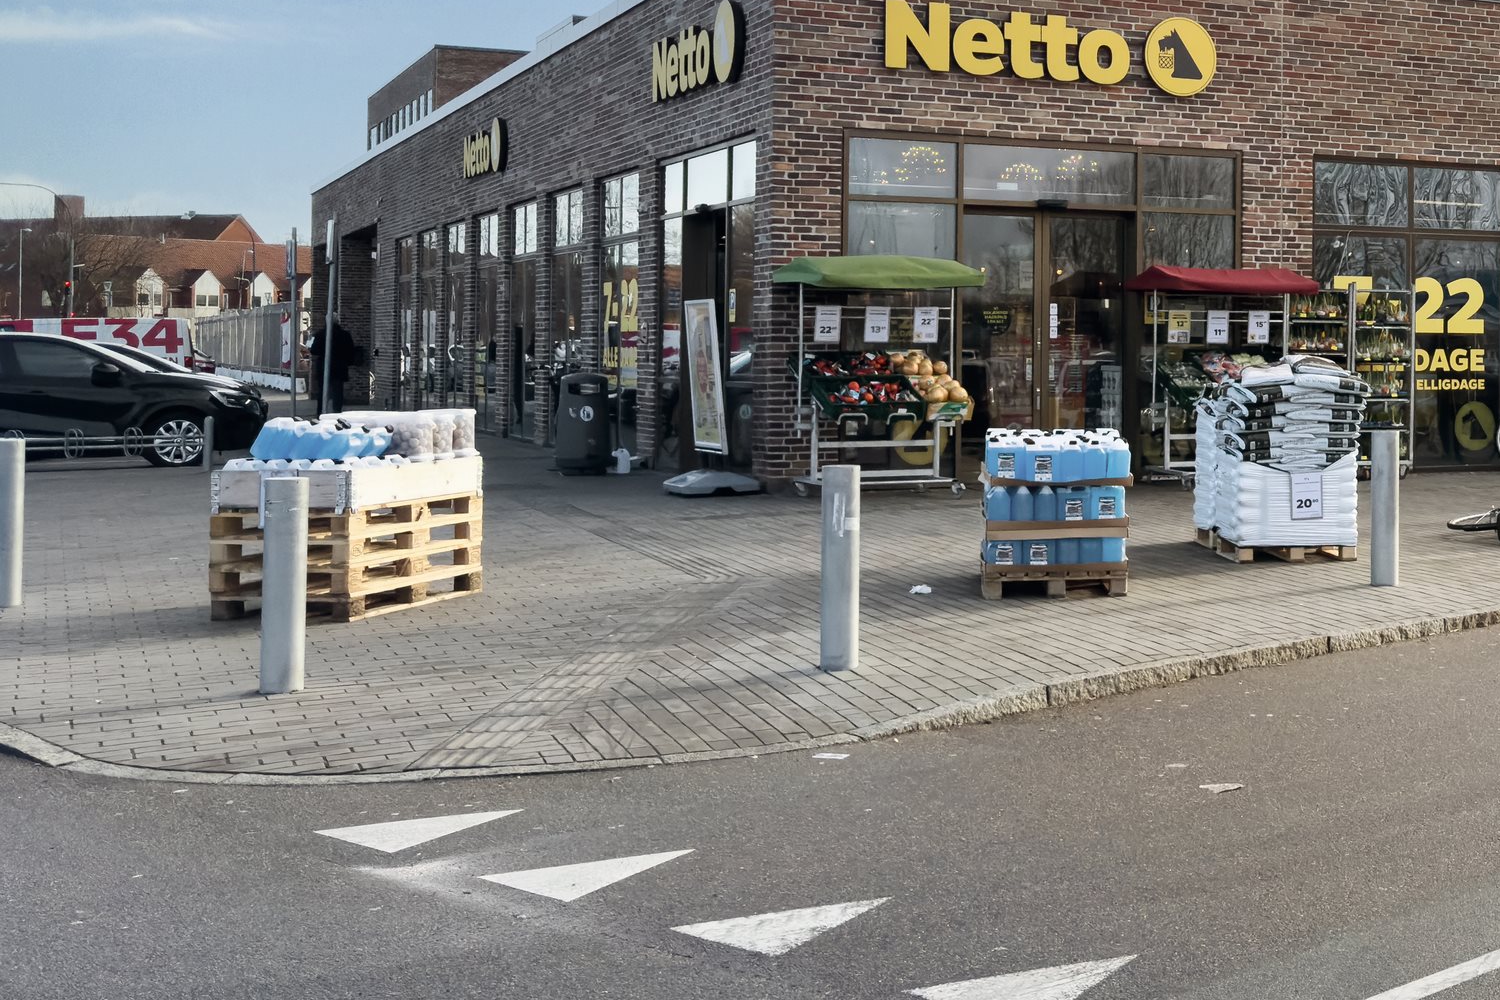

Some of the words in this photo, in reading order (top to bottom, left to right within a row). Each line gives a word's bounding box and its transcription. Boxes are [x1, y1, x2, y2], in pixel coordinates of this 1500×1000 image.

[652, 25, 710, 103] Netto
[463, 130, 490, 179] Netto
[1414, 348, 1486, 373] DAGE
[1396, 379, 1486, 391] ELLIGDAGE
